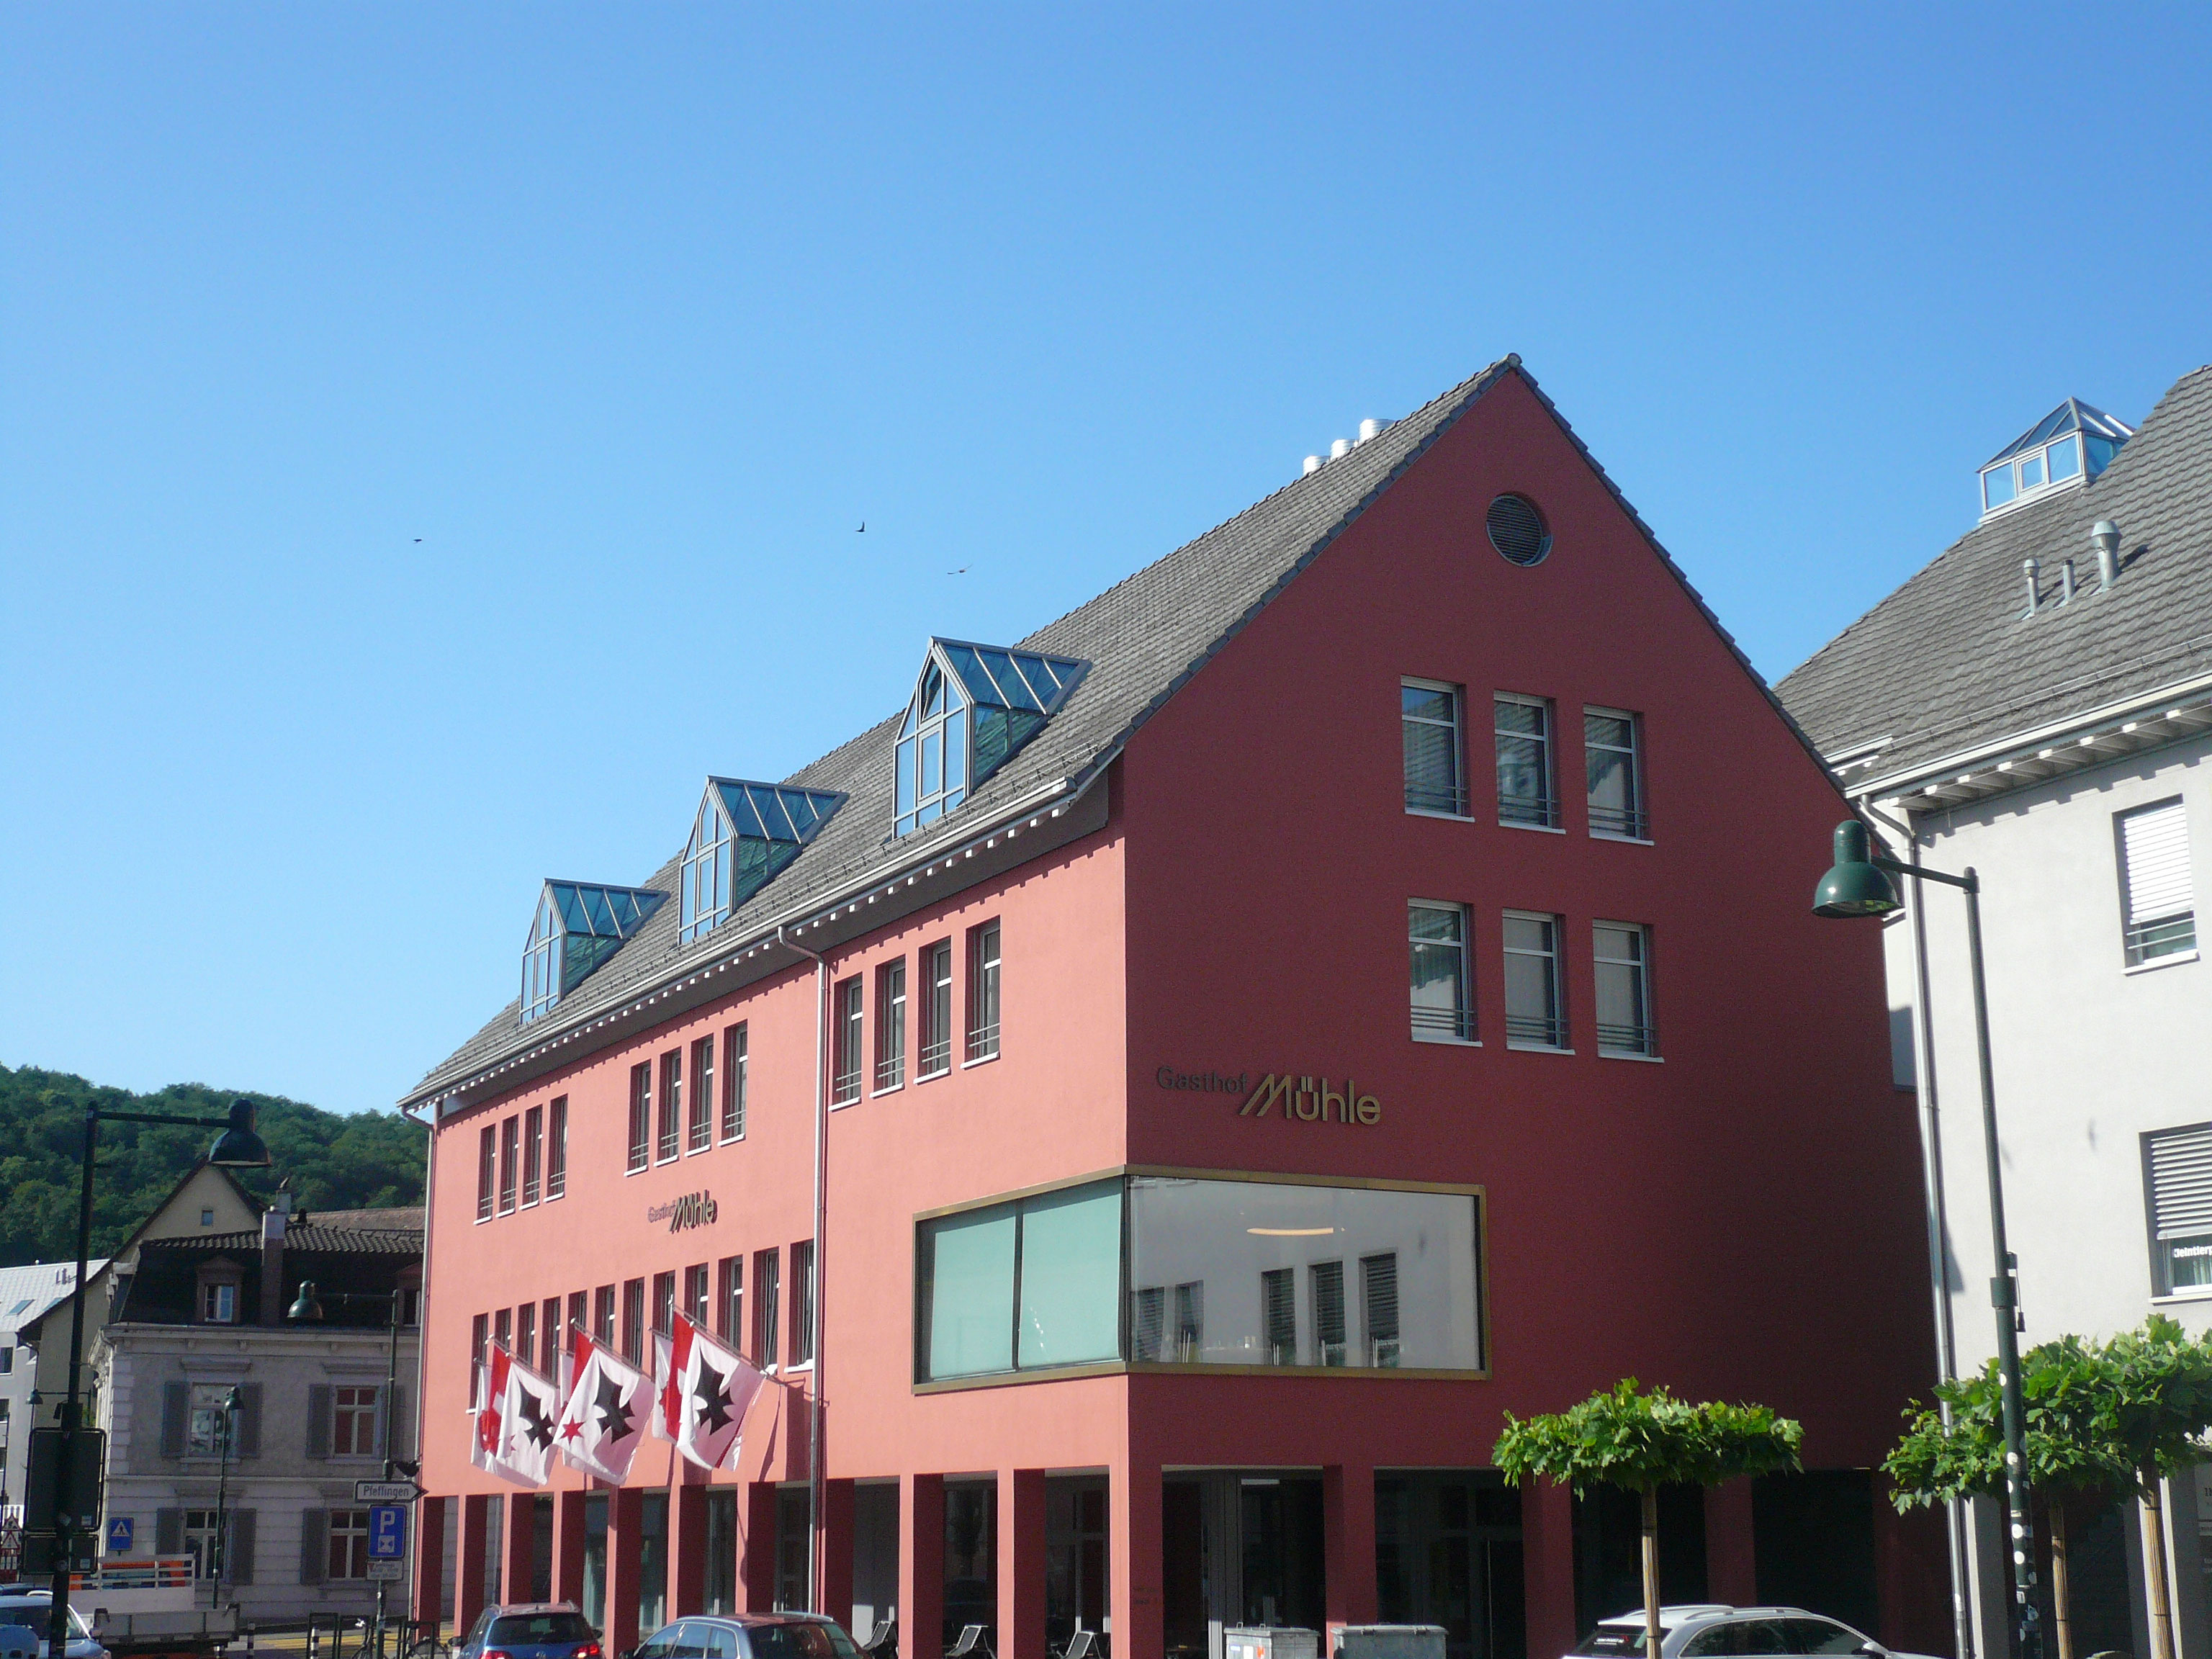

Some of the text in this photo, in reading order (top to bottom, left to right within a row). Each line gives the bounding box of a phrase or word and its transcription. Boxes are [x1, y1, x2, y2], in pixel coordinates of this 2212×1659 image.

[1158, 1066, 1380, 1125] Gasthof Mühle
[669, 1189, 716, 1233] Mühle
[364, 1485, 409, 1498] Pfeffingen
[380, 1511, 395, 1534] P
